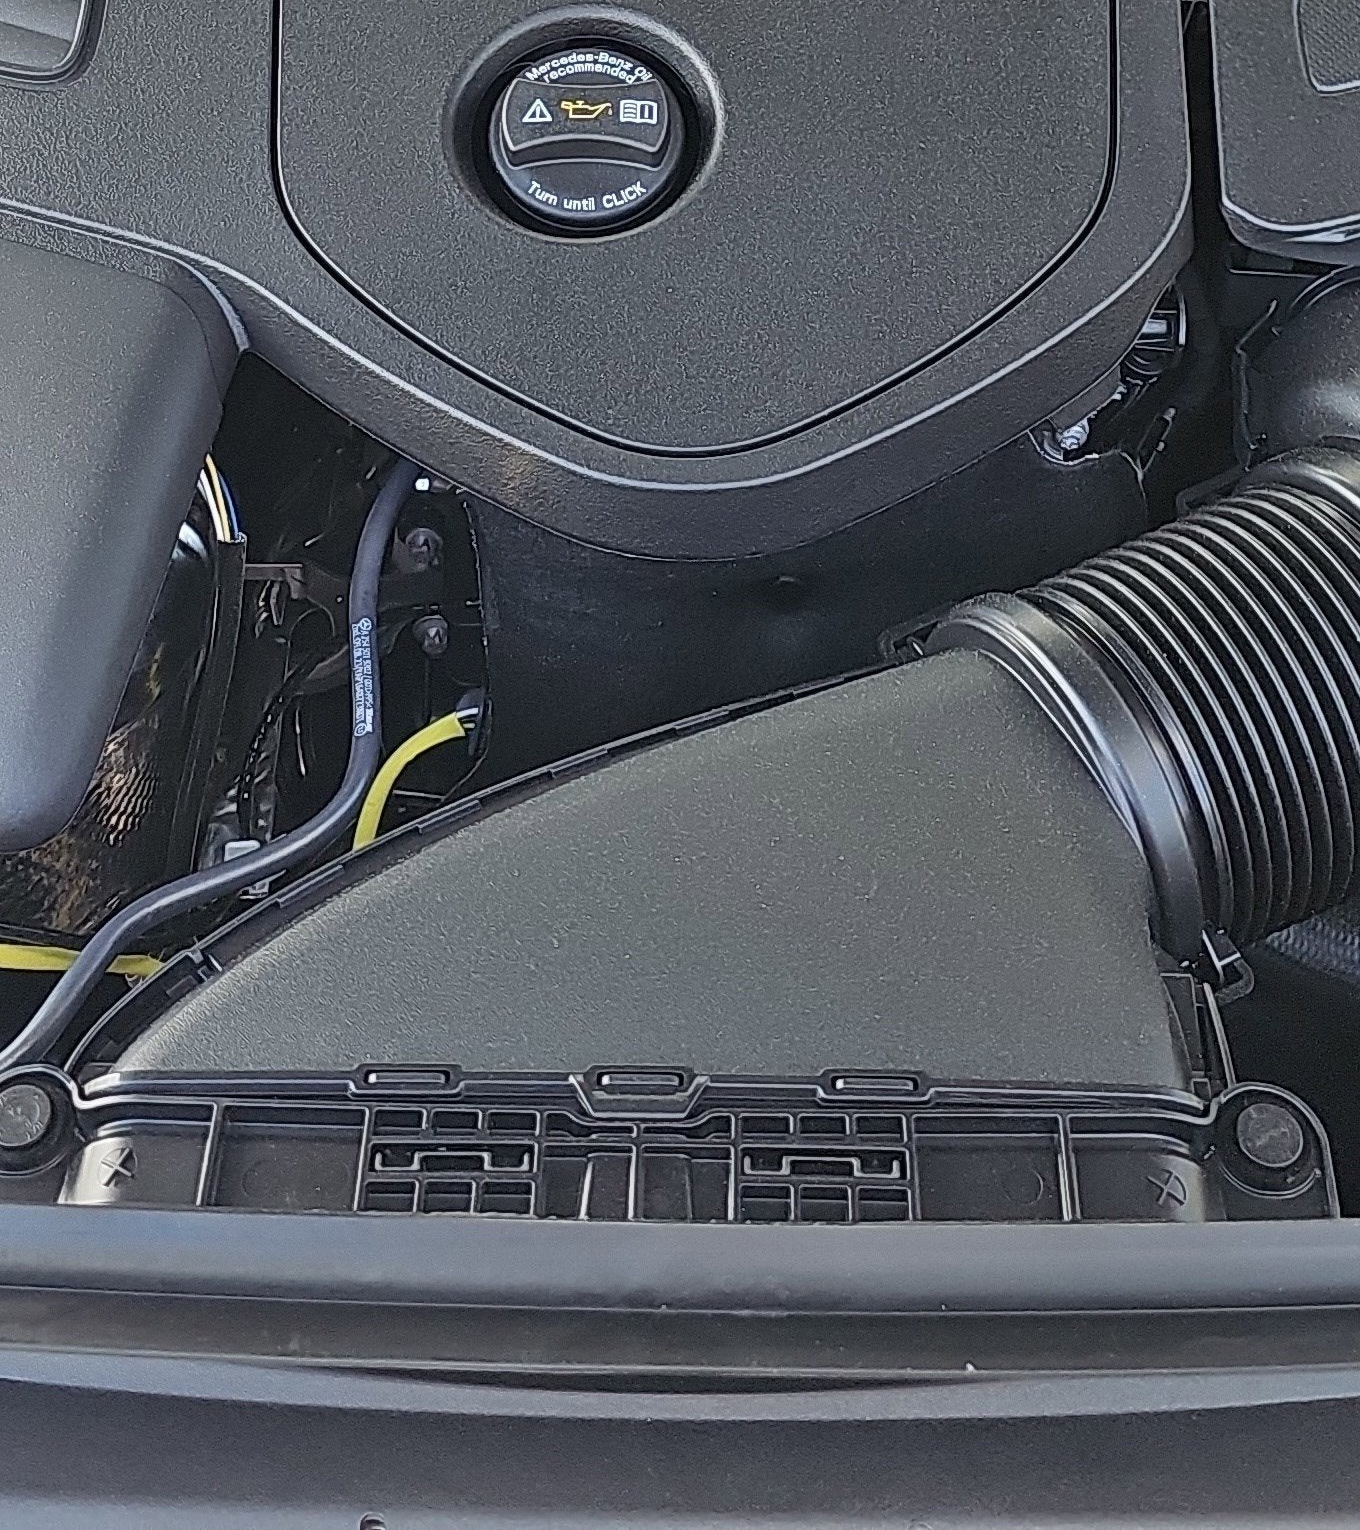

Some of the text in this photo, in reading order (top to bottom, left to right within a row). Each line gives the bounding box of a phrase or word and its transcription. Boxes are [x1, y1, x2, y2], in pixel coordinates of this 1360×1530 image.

[524, 51, 654, 82] Mercedes-Benz Oil
[543, 62, 637, 85] recommended
[526, 180, 647, 211] Turn until CLICK
